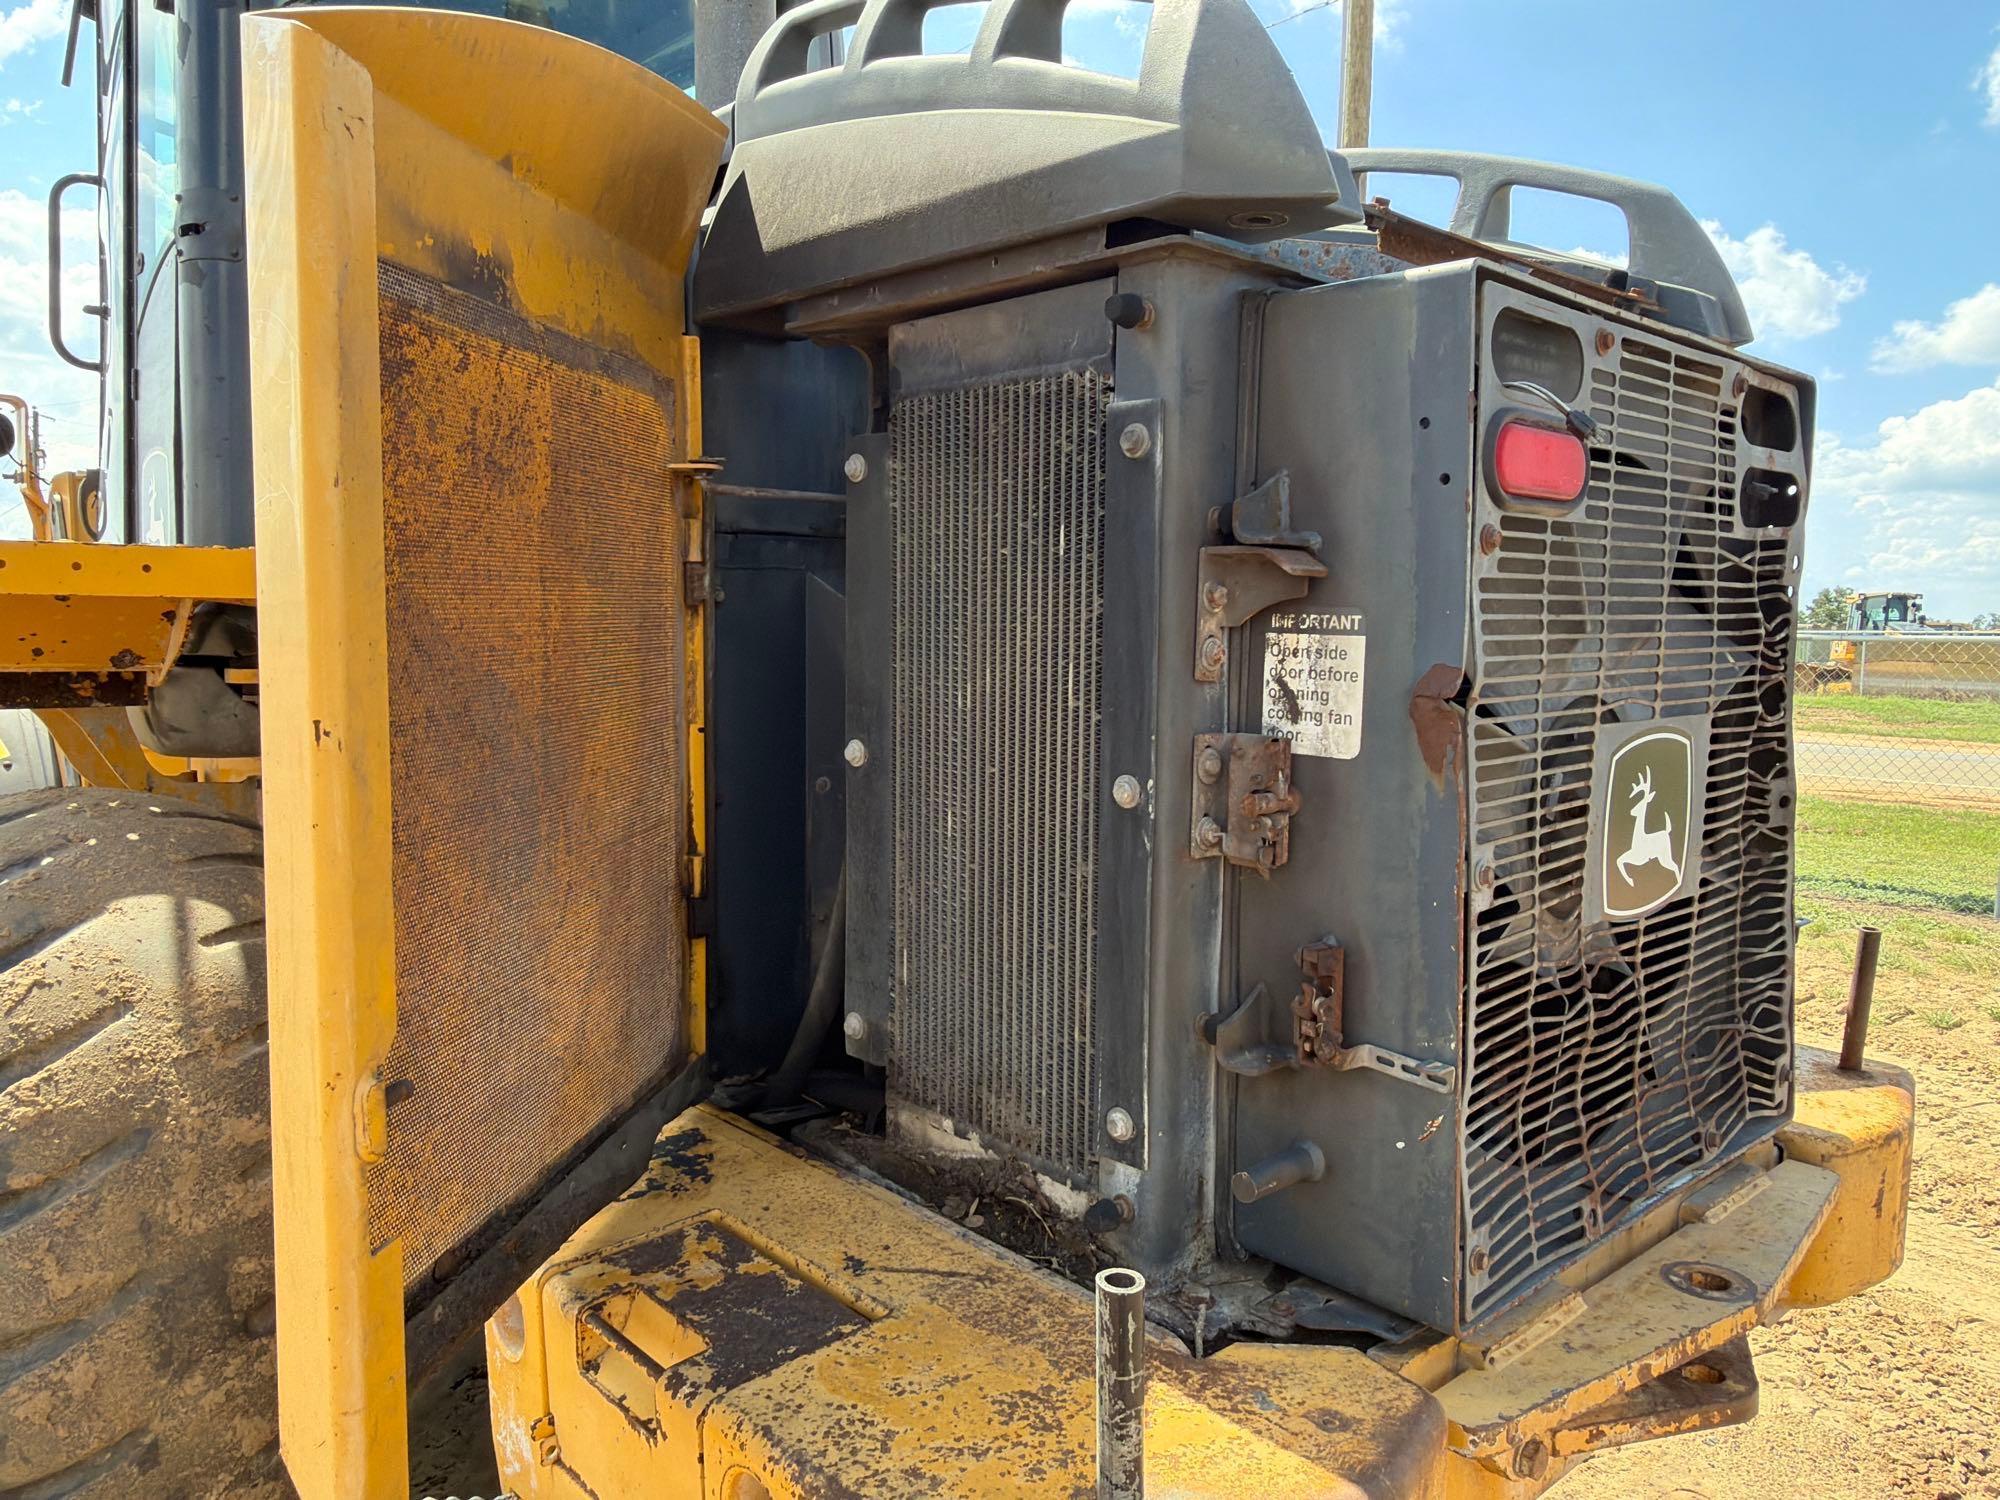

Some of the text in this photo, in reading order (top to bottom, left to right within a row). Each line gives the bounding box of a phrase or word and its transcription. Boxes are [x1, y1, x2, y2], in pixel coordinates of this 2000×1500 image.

[1270, 643, 1348, 660] Open side
[1270, 665, 1358, 682] door before
[1268, 687, 1330, 706] opning
[1267, 707, 1352, 726] cooing fan
